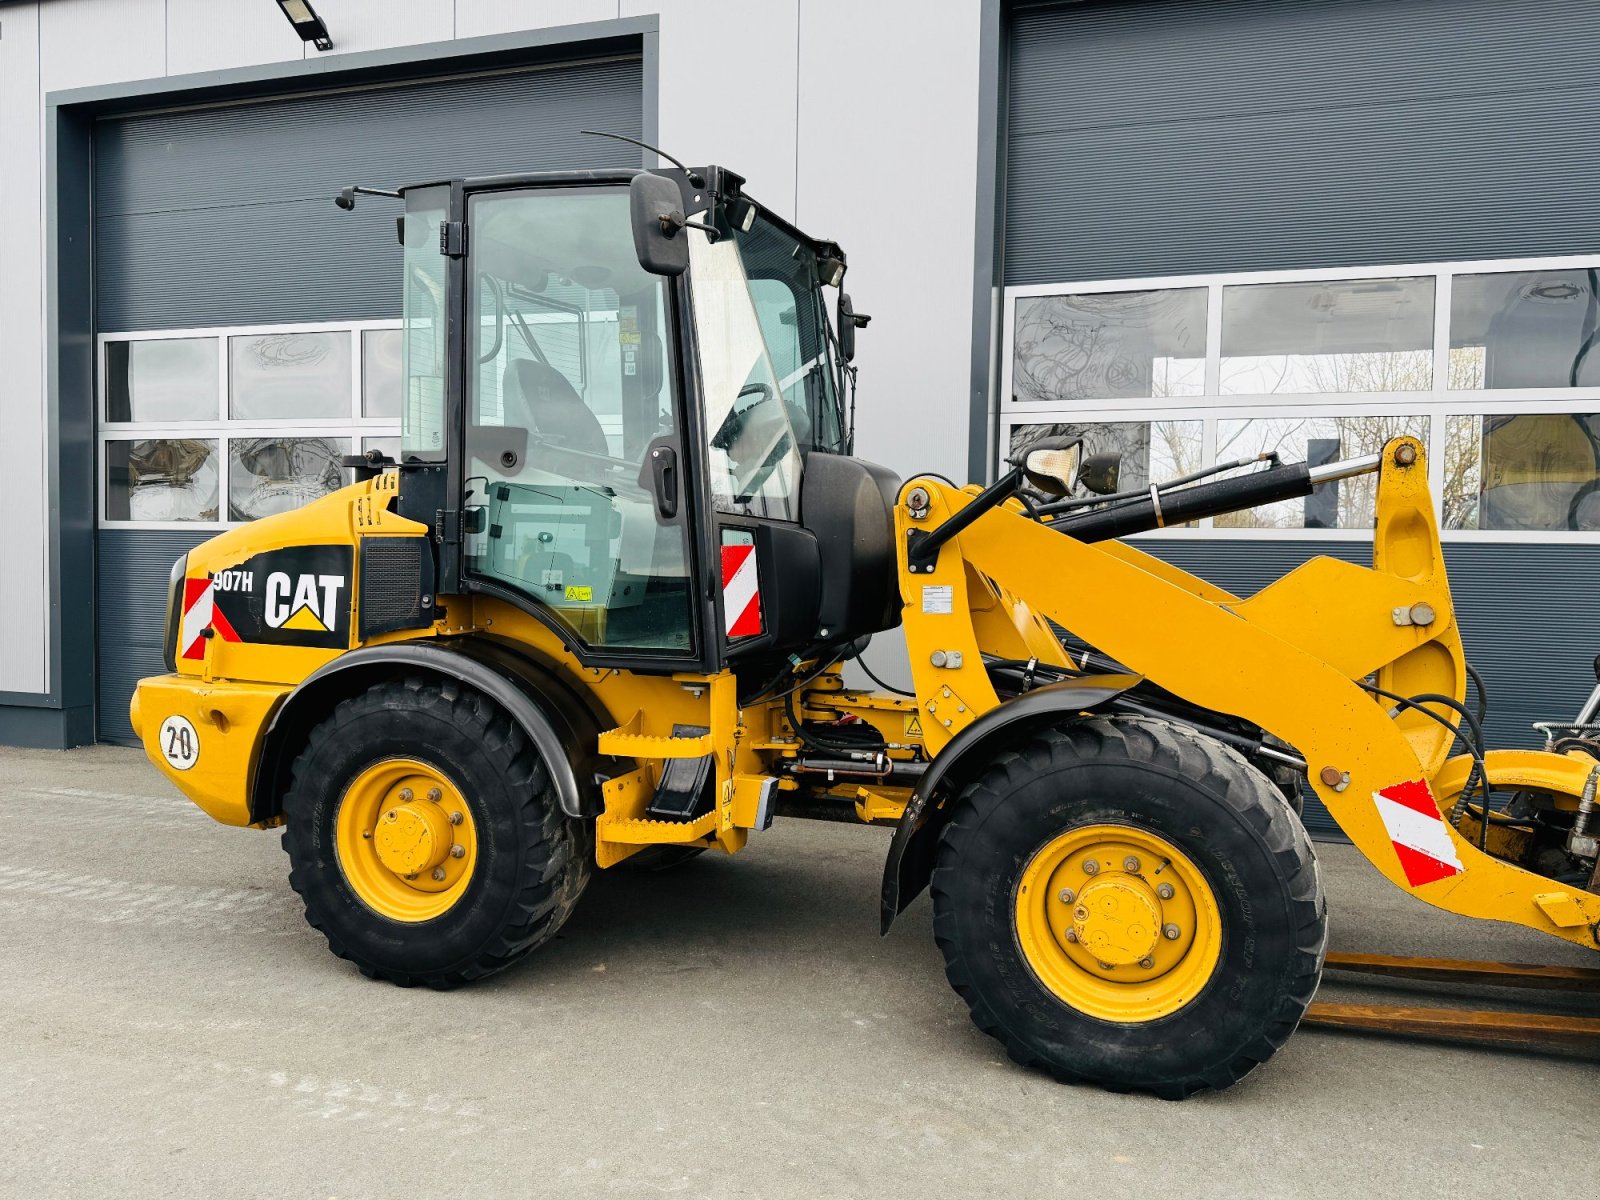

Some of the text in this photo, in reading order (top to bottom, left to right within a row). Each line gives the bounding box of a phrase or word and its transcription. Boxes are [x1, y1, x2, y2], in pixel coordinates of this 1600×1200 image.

[213, 571, 254, 592] 907H
[265, 571, 345, 632] CAT
[166, 725, 192, 761] 20
